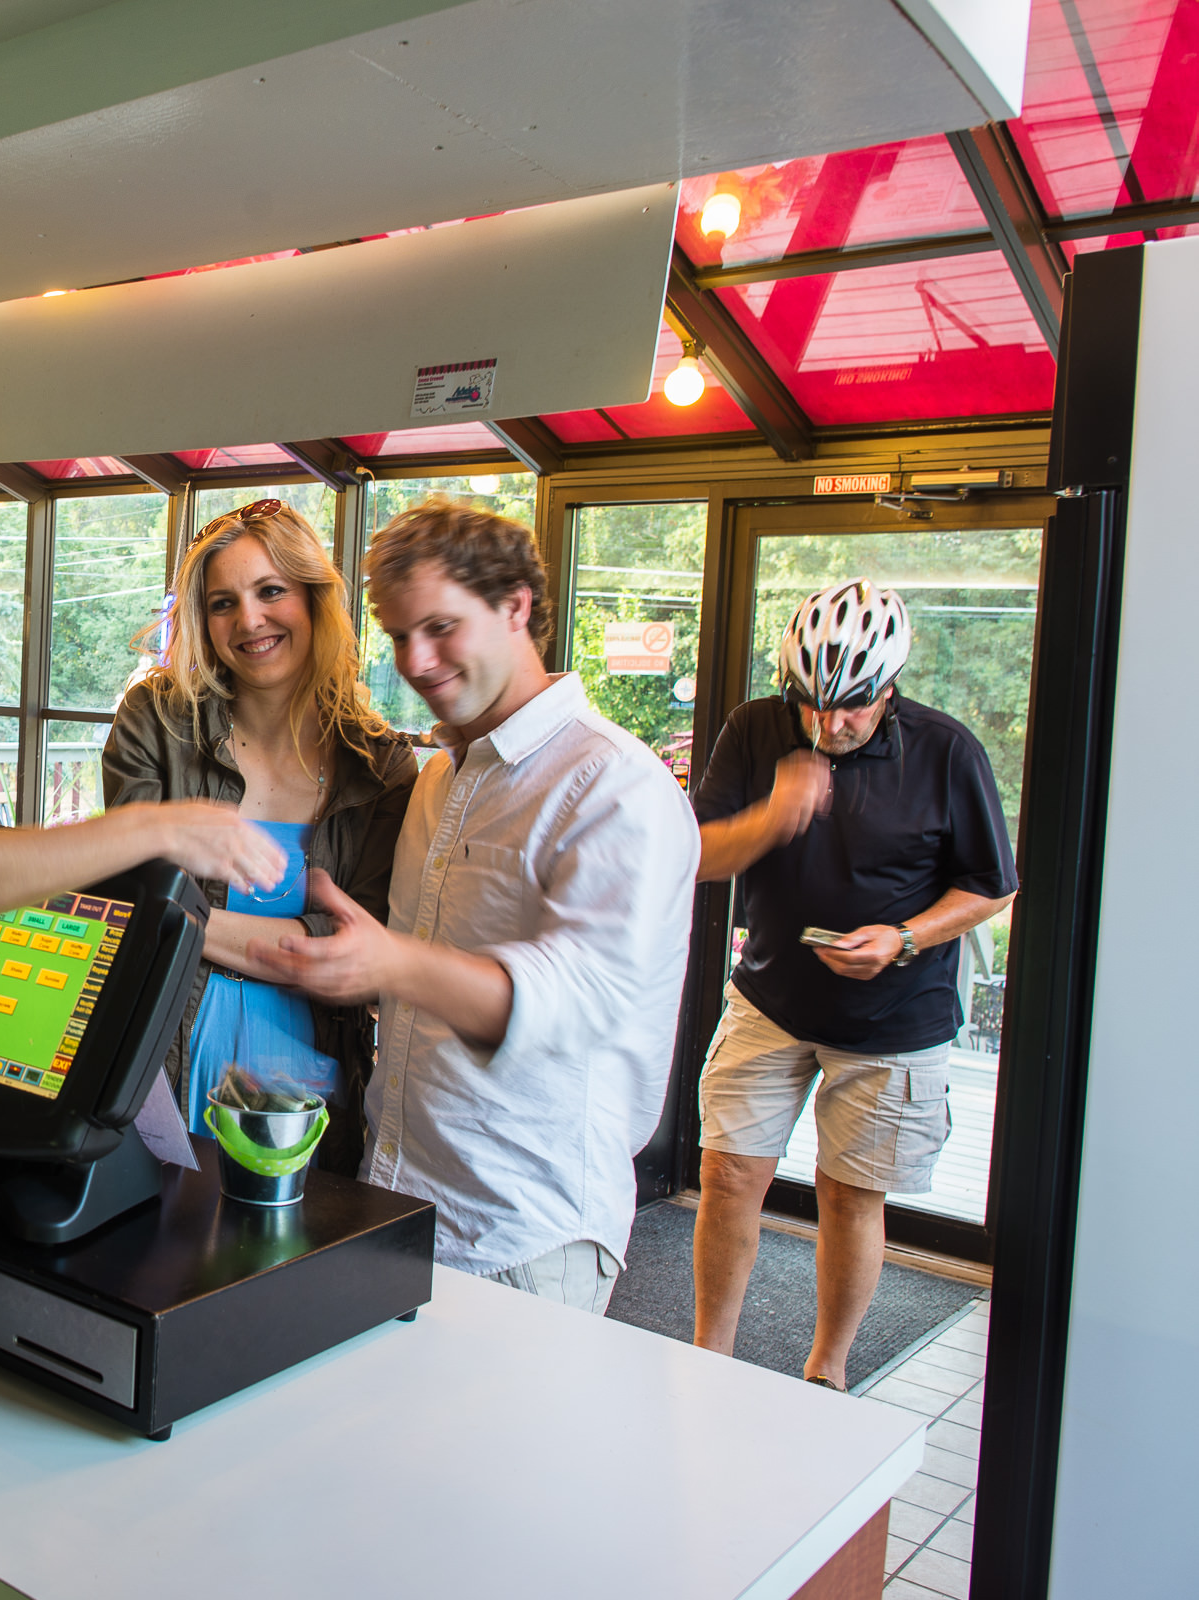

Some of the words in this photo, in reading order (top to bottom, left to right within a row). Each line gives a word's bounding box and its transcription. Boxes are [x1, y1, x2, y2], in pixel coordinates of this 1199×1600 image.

[817, 478, 834, 493] NO
[834, 476, 887, 492] SMOKING
[61, 921, 80, 932] LARGE
